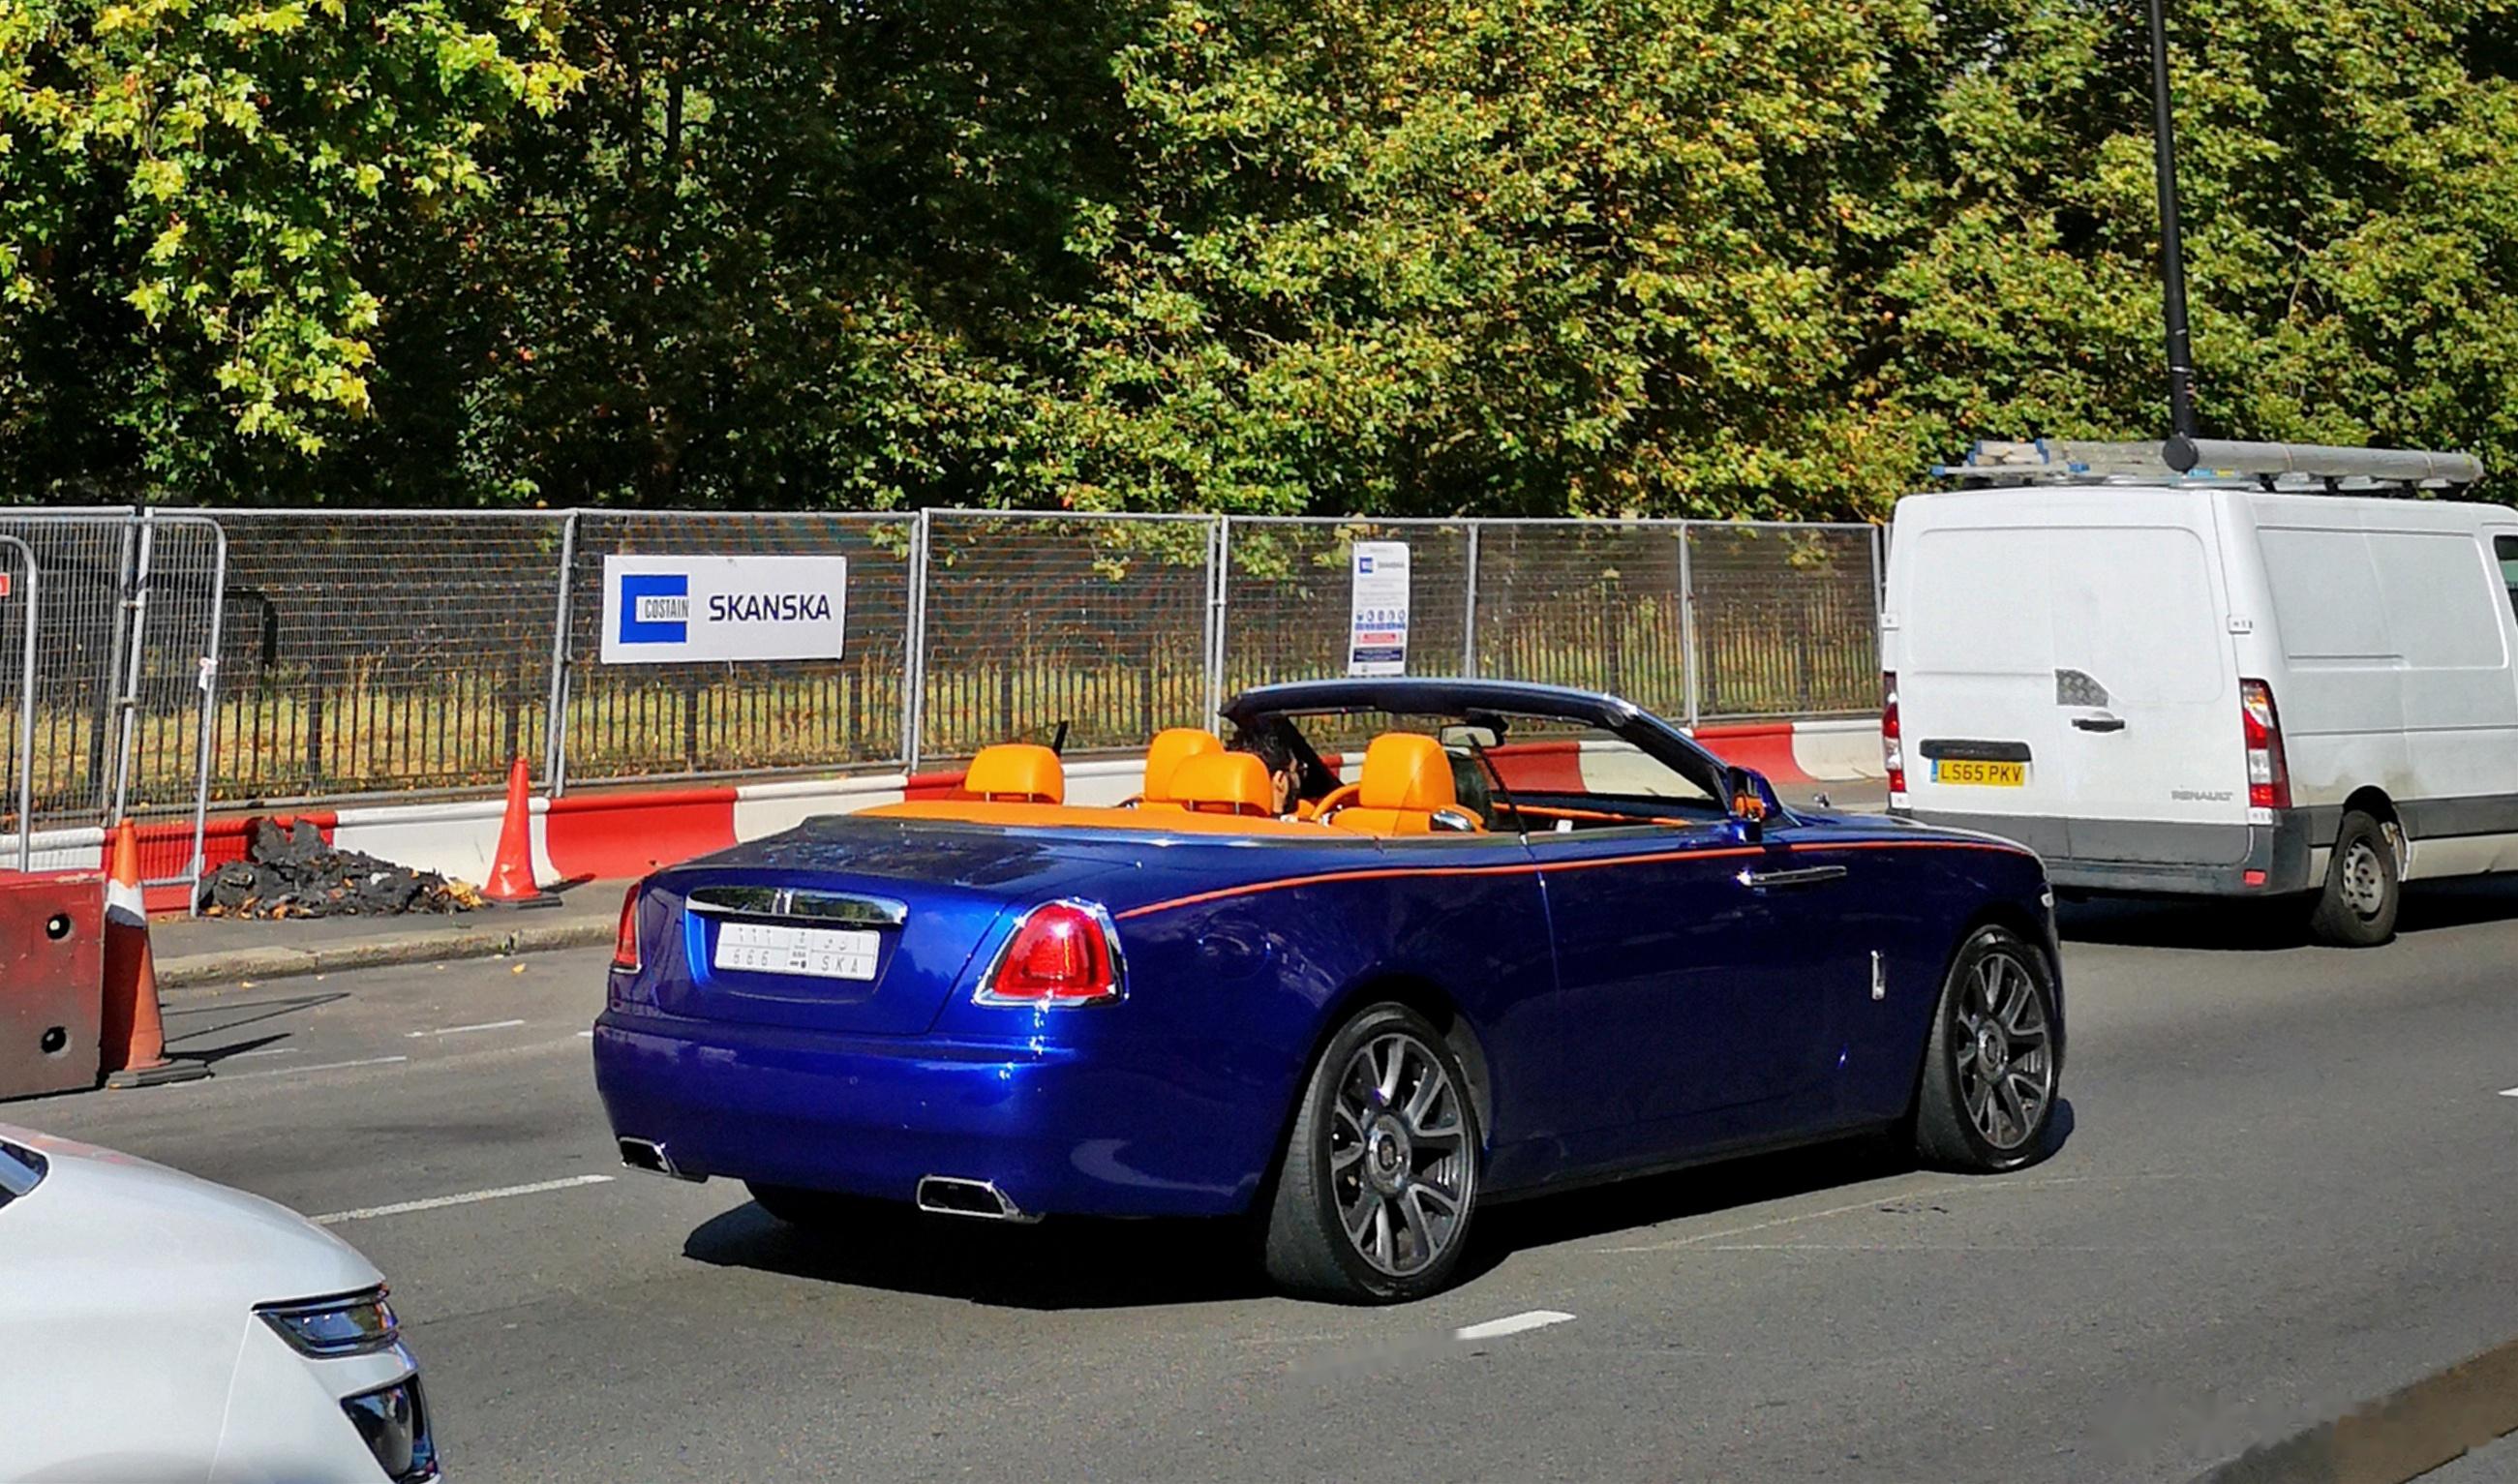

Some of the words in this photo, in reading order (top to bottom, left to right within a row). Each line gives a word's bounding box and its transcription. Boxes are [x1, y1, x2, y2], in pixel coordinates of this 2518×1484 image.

[644, 598, 688, 620] COSTAIN
[709, 594, 831, 621] SKANSKA
[1941, 764, 1984, 781] LS65
[1988, 765, 2021, 782] PKV
[2171, 790, 2232, 802] RENAULT
[821, 955, 859, 974] SKA
